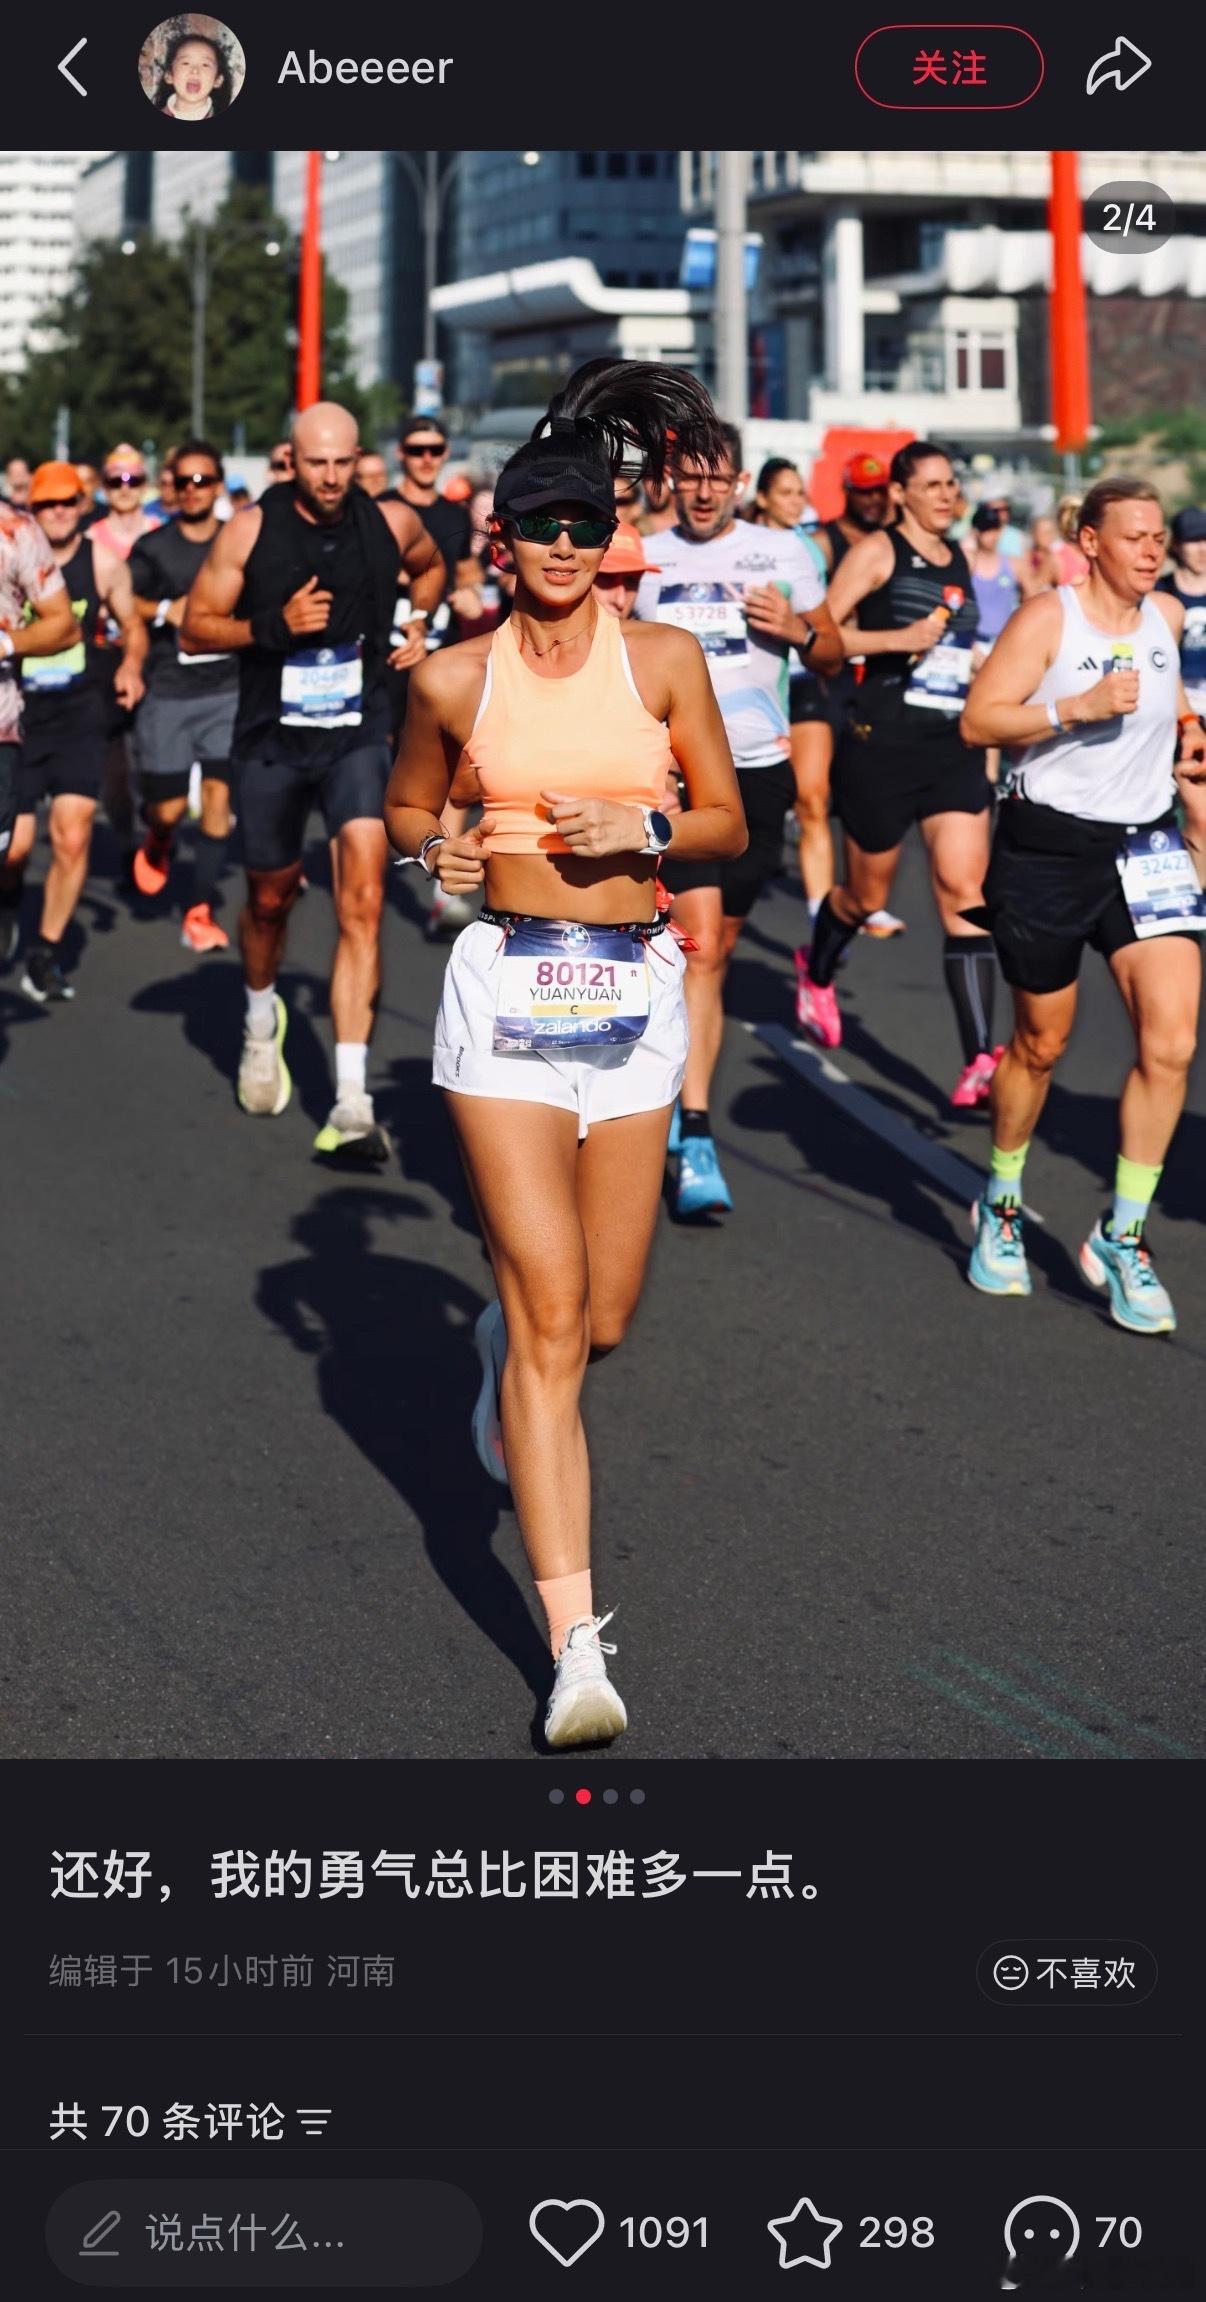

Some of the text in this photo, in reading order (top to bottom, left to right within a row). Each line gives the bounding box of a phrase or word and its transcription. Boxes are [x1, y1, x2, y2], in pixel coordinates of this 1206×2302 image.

[536, 961, 616, 987] 80121
[529, 987, 622, 1001] YUANYUAN
[570, 1005, 579, 1015] C
[534, 1020, 611, 1035] zalando
